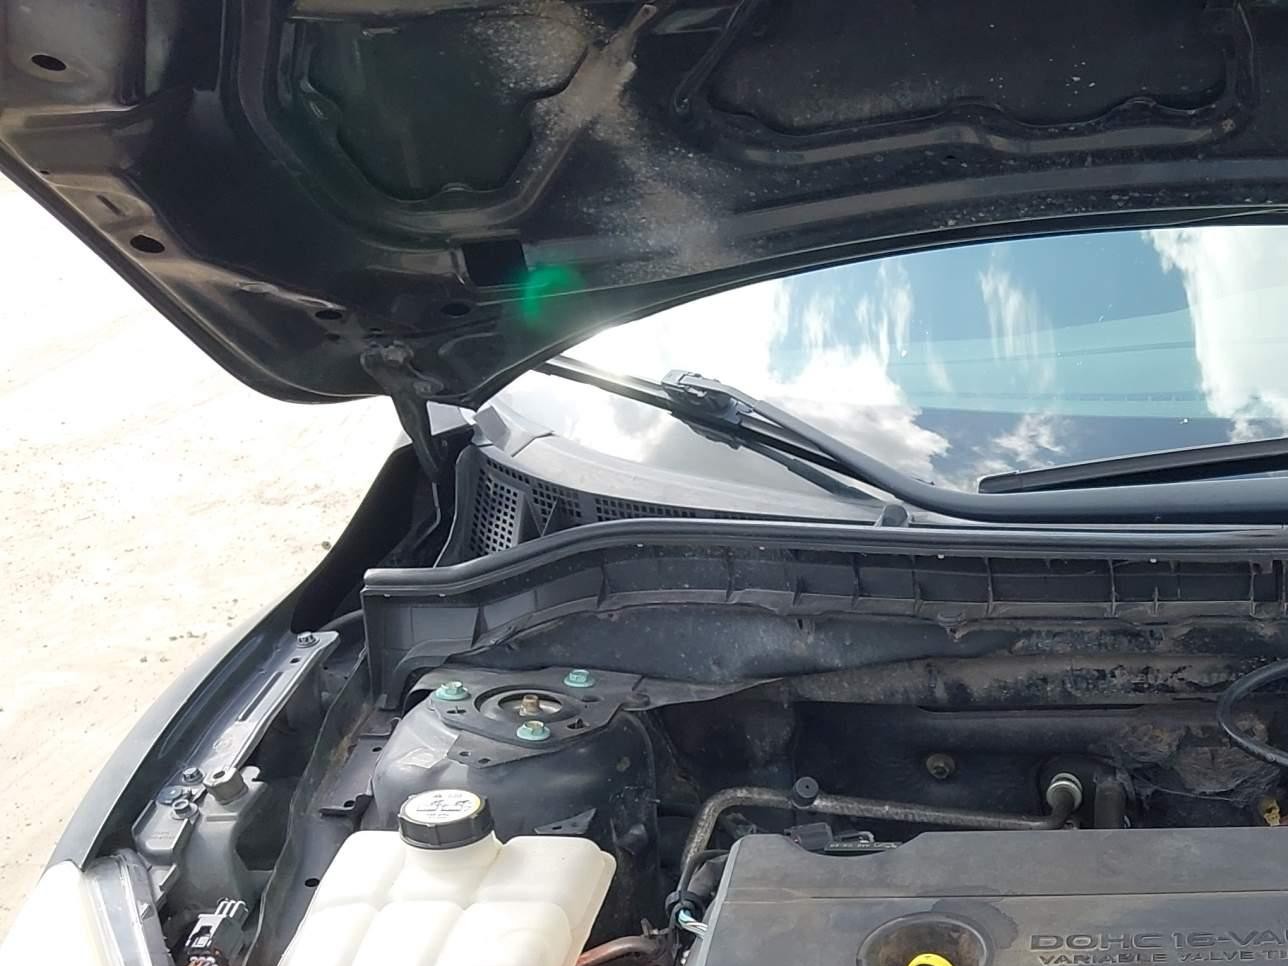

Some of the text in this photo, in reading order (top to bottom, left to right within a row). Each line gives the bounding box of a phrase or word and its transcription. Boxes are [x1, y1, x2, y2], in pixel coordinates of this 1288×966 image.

[1029, 933, 1165, 950] DOHC
[1038, 952, 1169, 966] VARIABLE
[1179, 950, 1255, 962] VALVE
